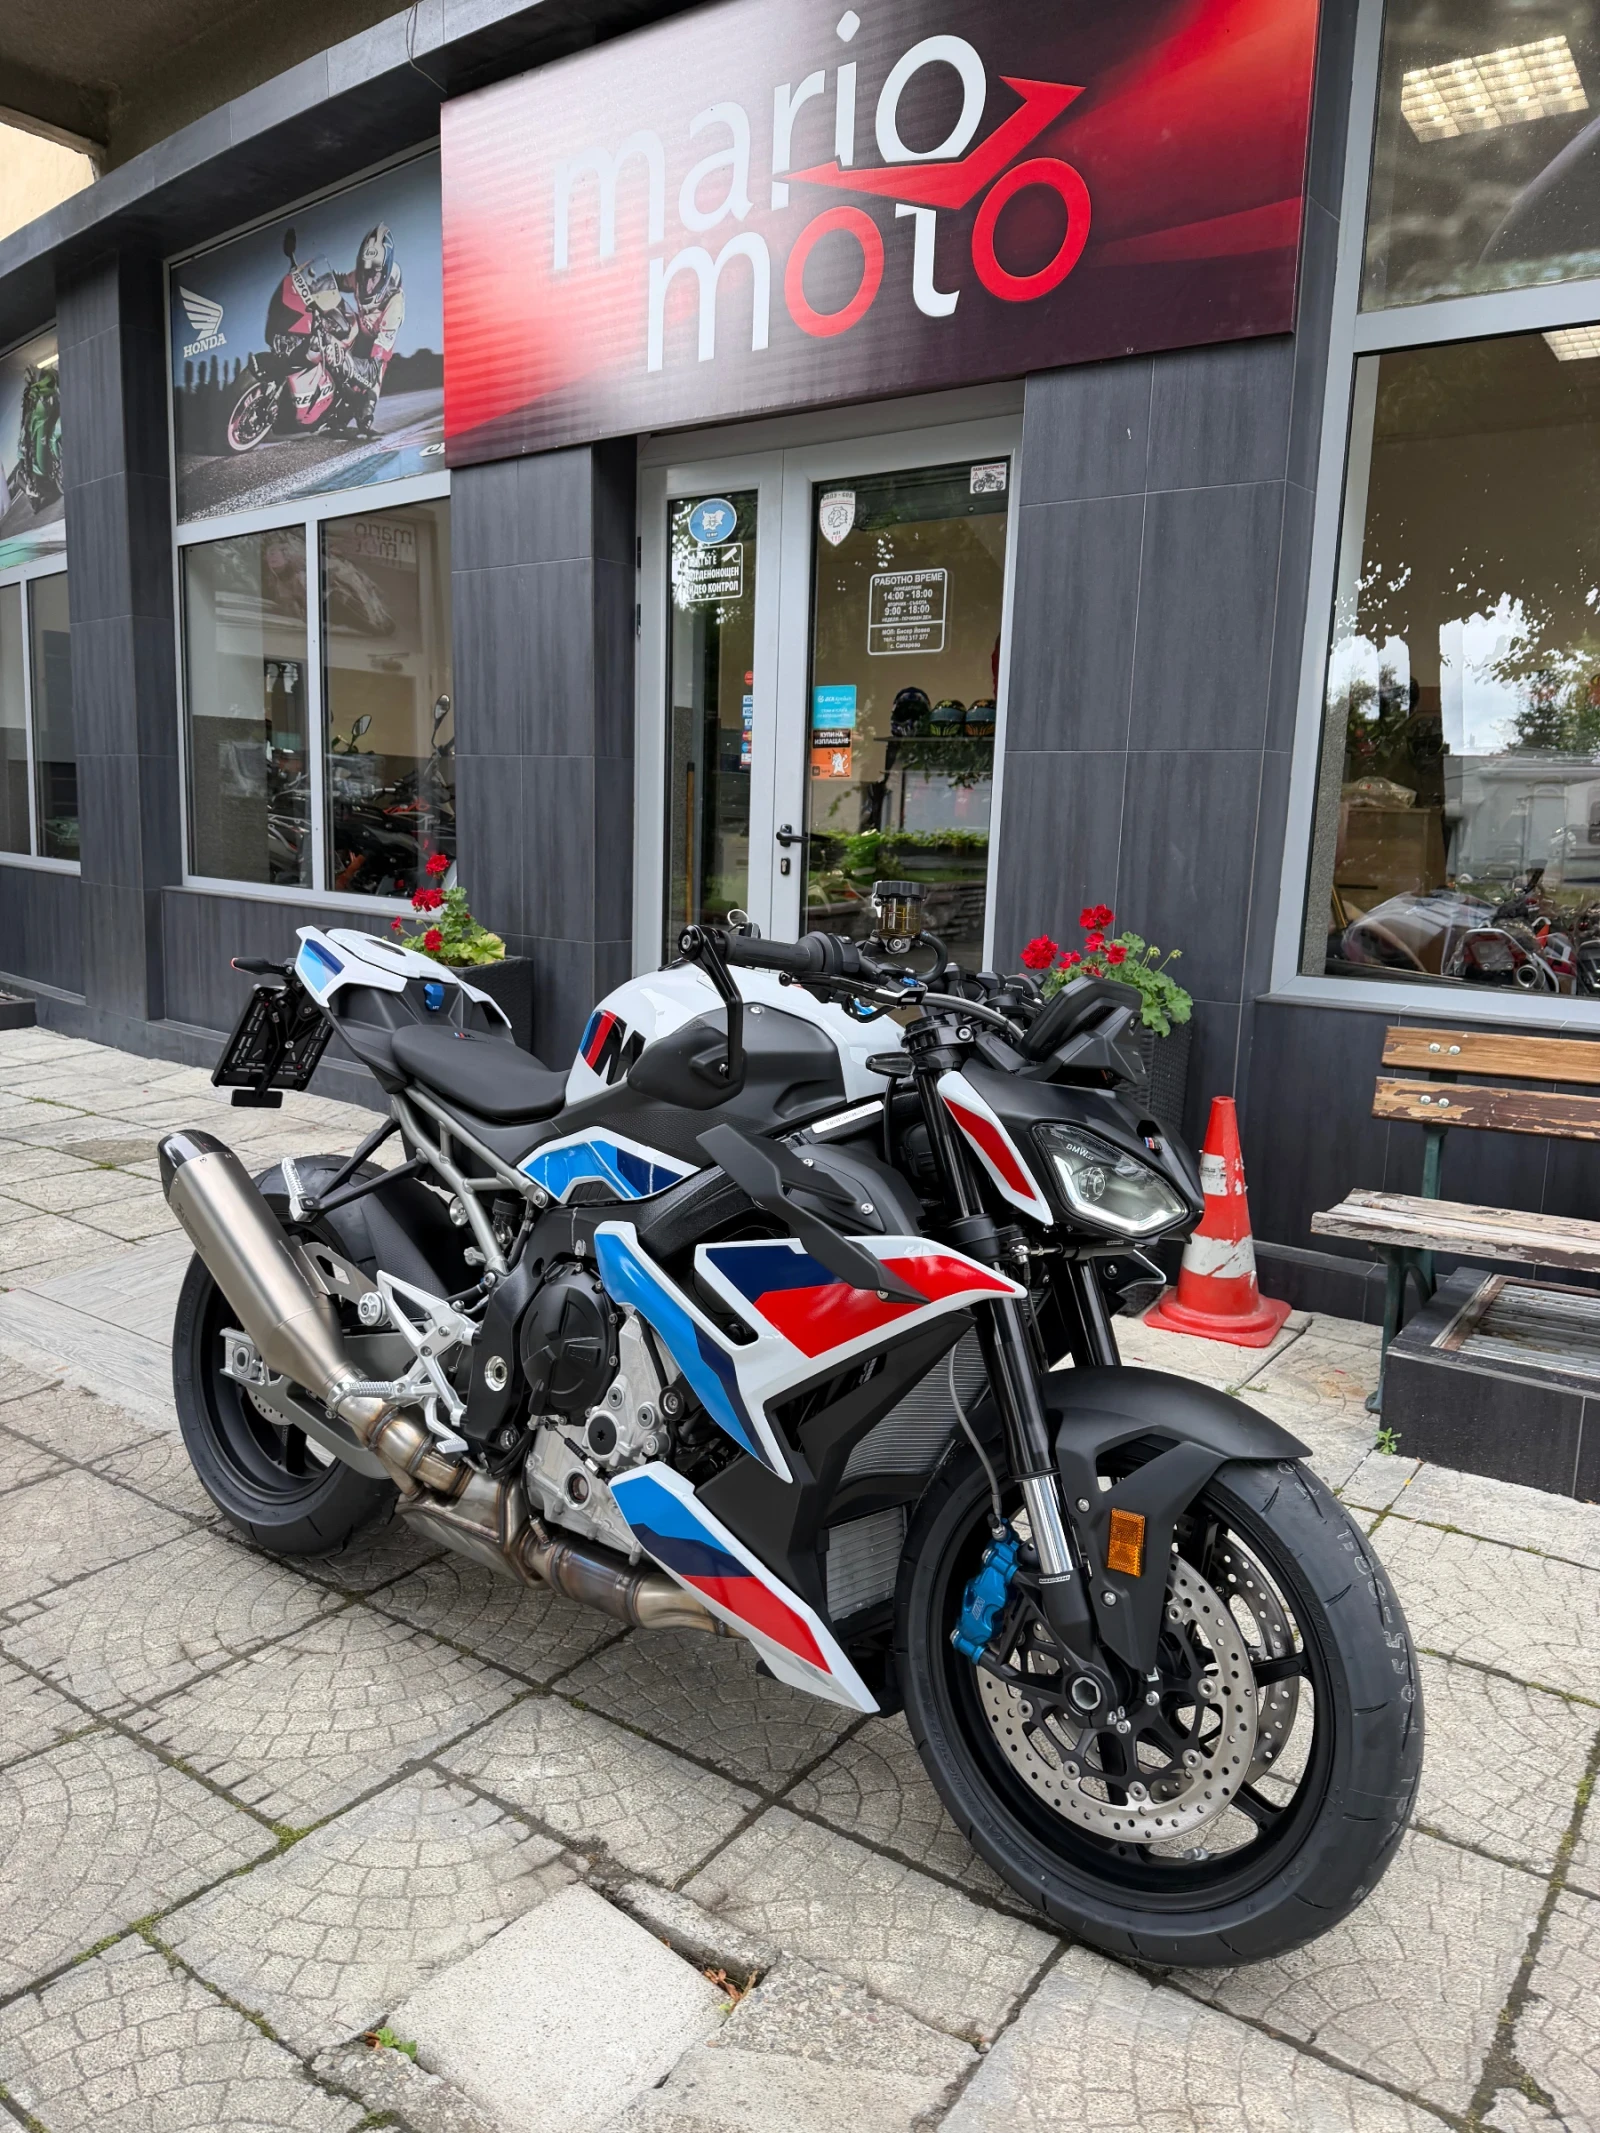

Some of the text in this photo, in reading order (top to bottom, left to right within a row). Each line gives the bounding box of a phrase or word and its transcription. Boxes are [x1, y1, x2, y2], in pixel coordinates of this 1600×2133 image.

[552, 9, 987, 271] mario
[646, 156, 1092, 373] moto
[183, 332, 227, 358] HONDA
[699, 566, 739, 581] ДЕНОНОЩЕН
[875, 572, 943, 586] РАБОТНО ВРЕМЕ
[708, 580, 738, 593] КОНТРОЛ
[884, 592, 904, 600] 14:00
[912, 589, 933, 598] 18:00
[884, 607, 901, 615] 9:00
[909, 605, 930, 614] 18:00
[1065, 1143, 1088, 1158] BMW
